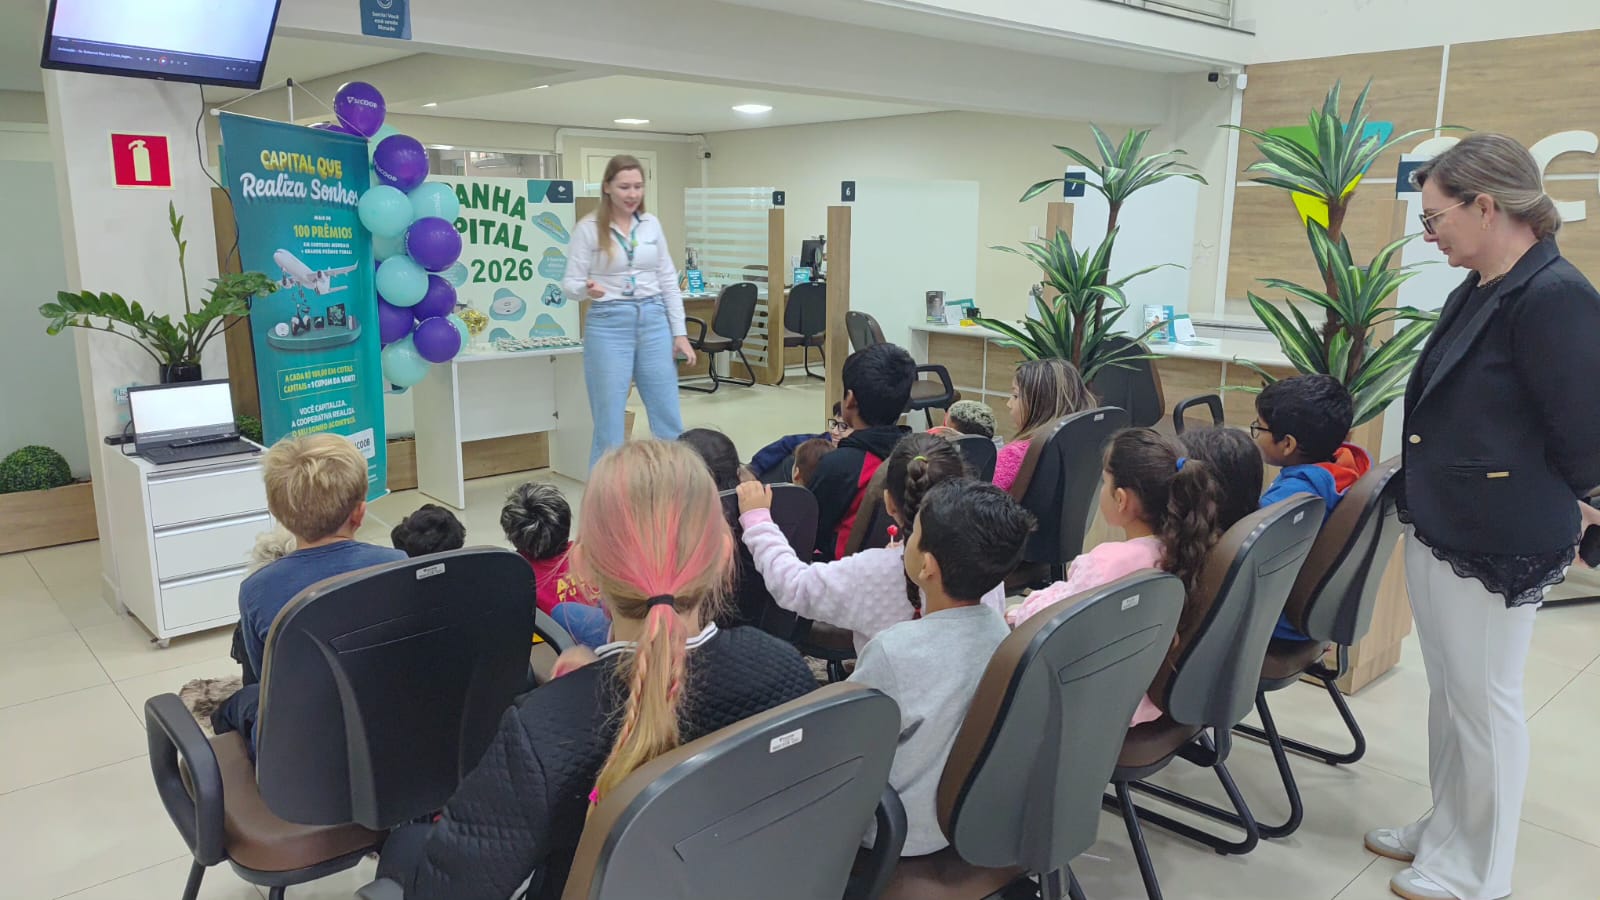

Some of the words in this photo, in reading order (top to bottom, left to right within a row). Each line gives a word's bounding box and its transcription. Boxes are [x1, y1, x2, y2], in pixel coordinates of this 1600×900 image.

[260, 149, 315, 174] CAPITAL
[317, 156, 342, 179] QUE
[240, 172, 307, 199] Realiza
[311, 178, 358, 207] Sonhos
[845, 187, 852, 197] 6
[442, 183, 527, 221] ANHA
[293, 224, 310, 239] 100
[311, 222, 353, 240] PRÊMIOS
[470, 258, 533, 284] 2026
[283, 382, 306, 393] CAPITAIS
[299, 404, 314, 415] VOCÊ
[297, 412, 331, 426] COOPERATIVA
